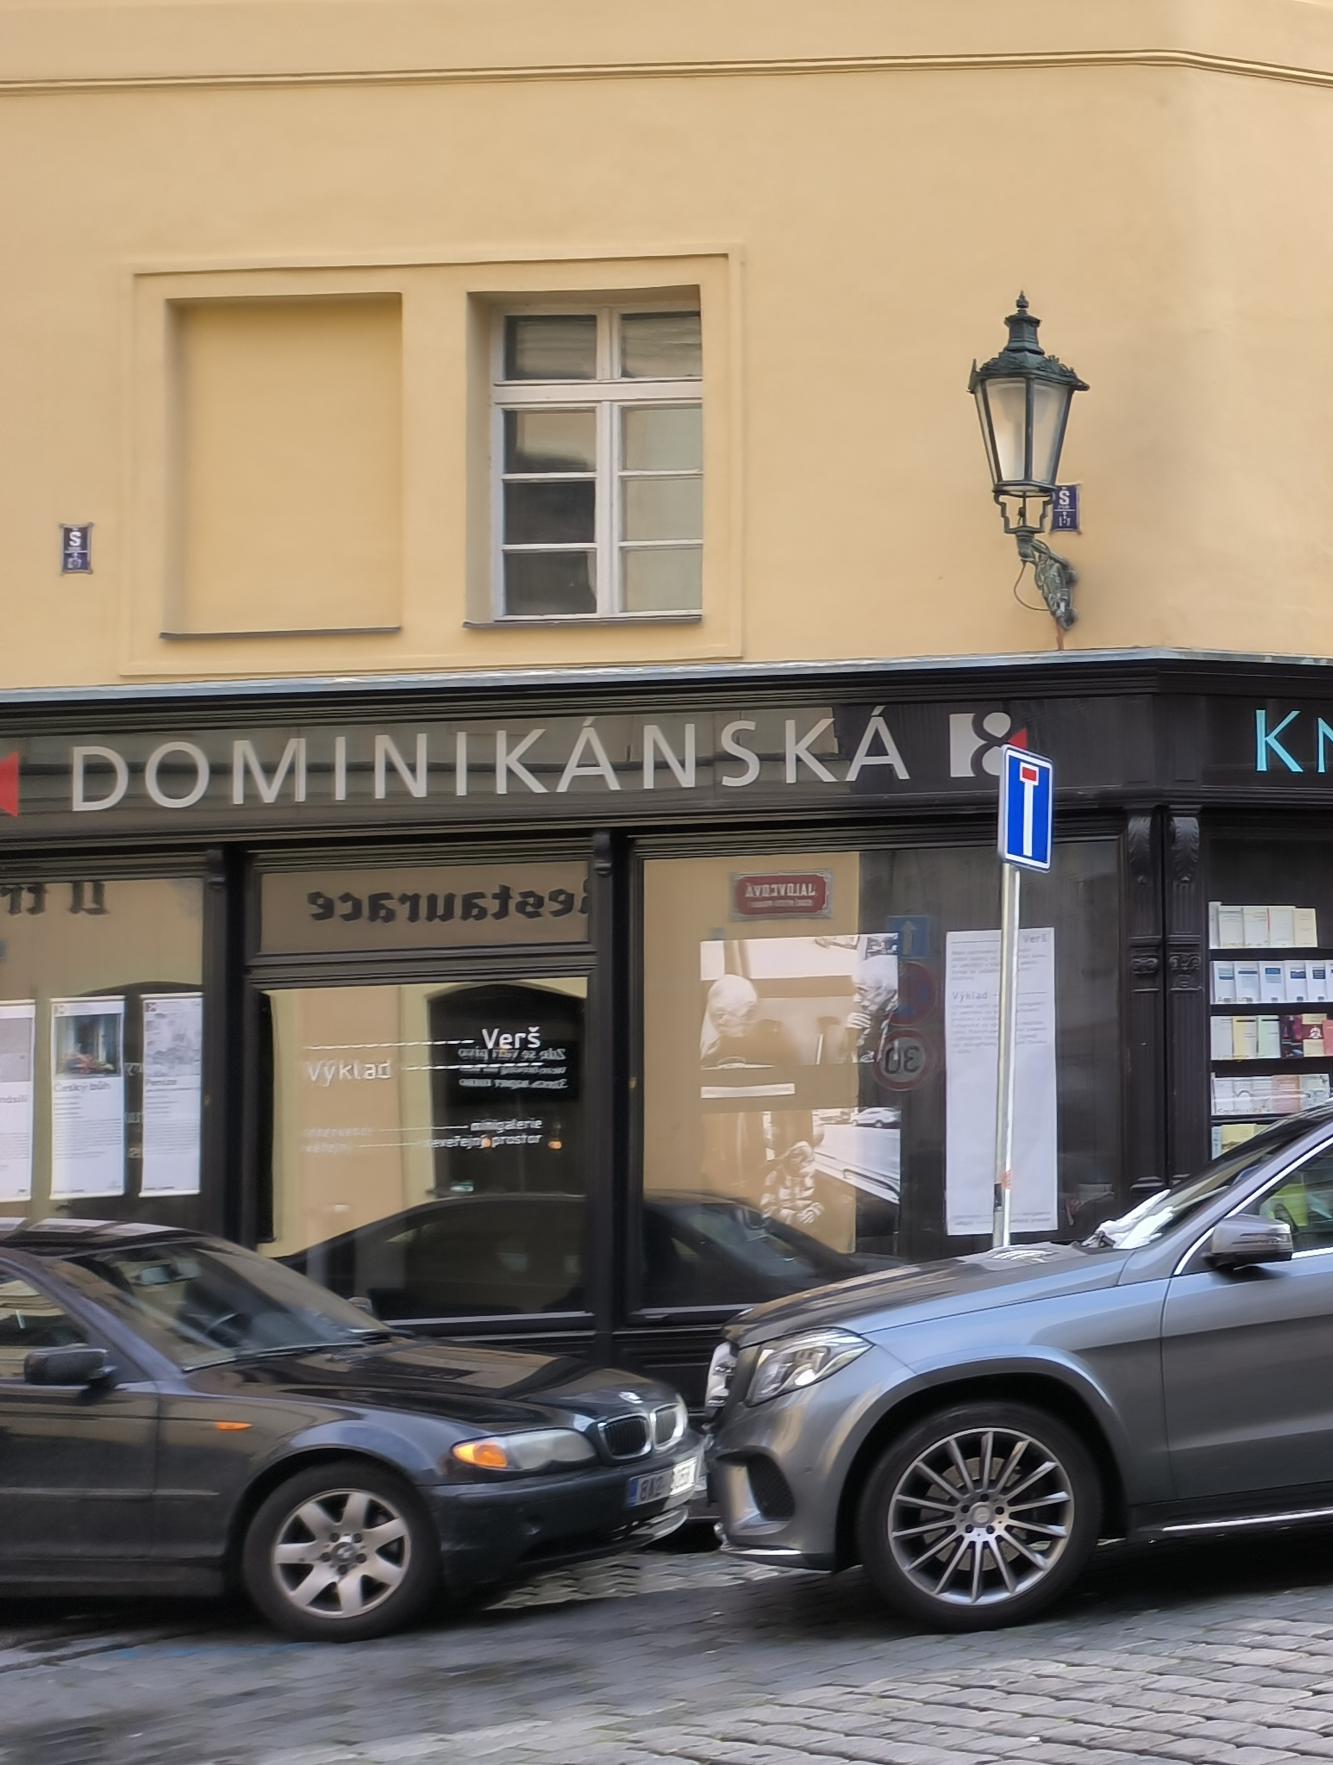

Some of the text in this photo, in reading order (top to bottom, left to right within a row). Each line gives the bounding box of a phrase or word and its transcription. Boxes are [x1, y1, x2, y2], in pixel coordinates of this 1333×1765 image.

[71, 706, 910, 812] DOMINIKÁNSKÁ
[482, 1026, 542, 1050] Verš
[305, 1059, 392, 1087] Výklad
